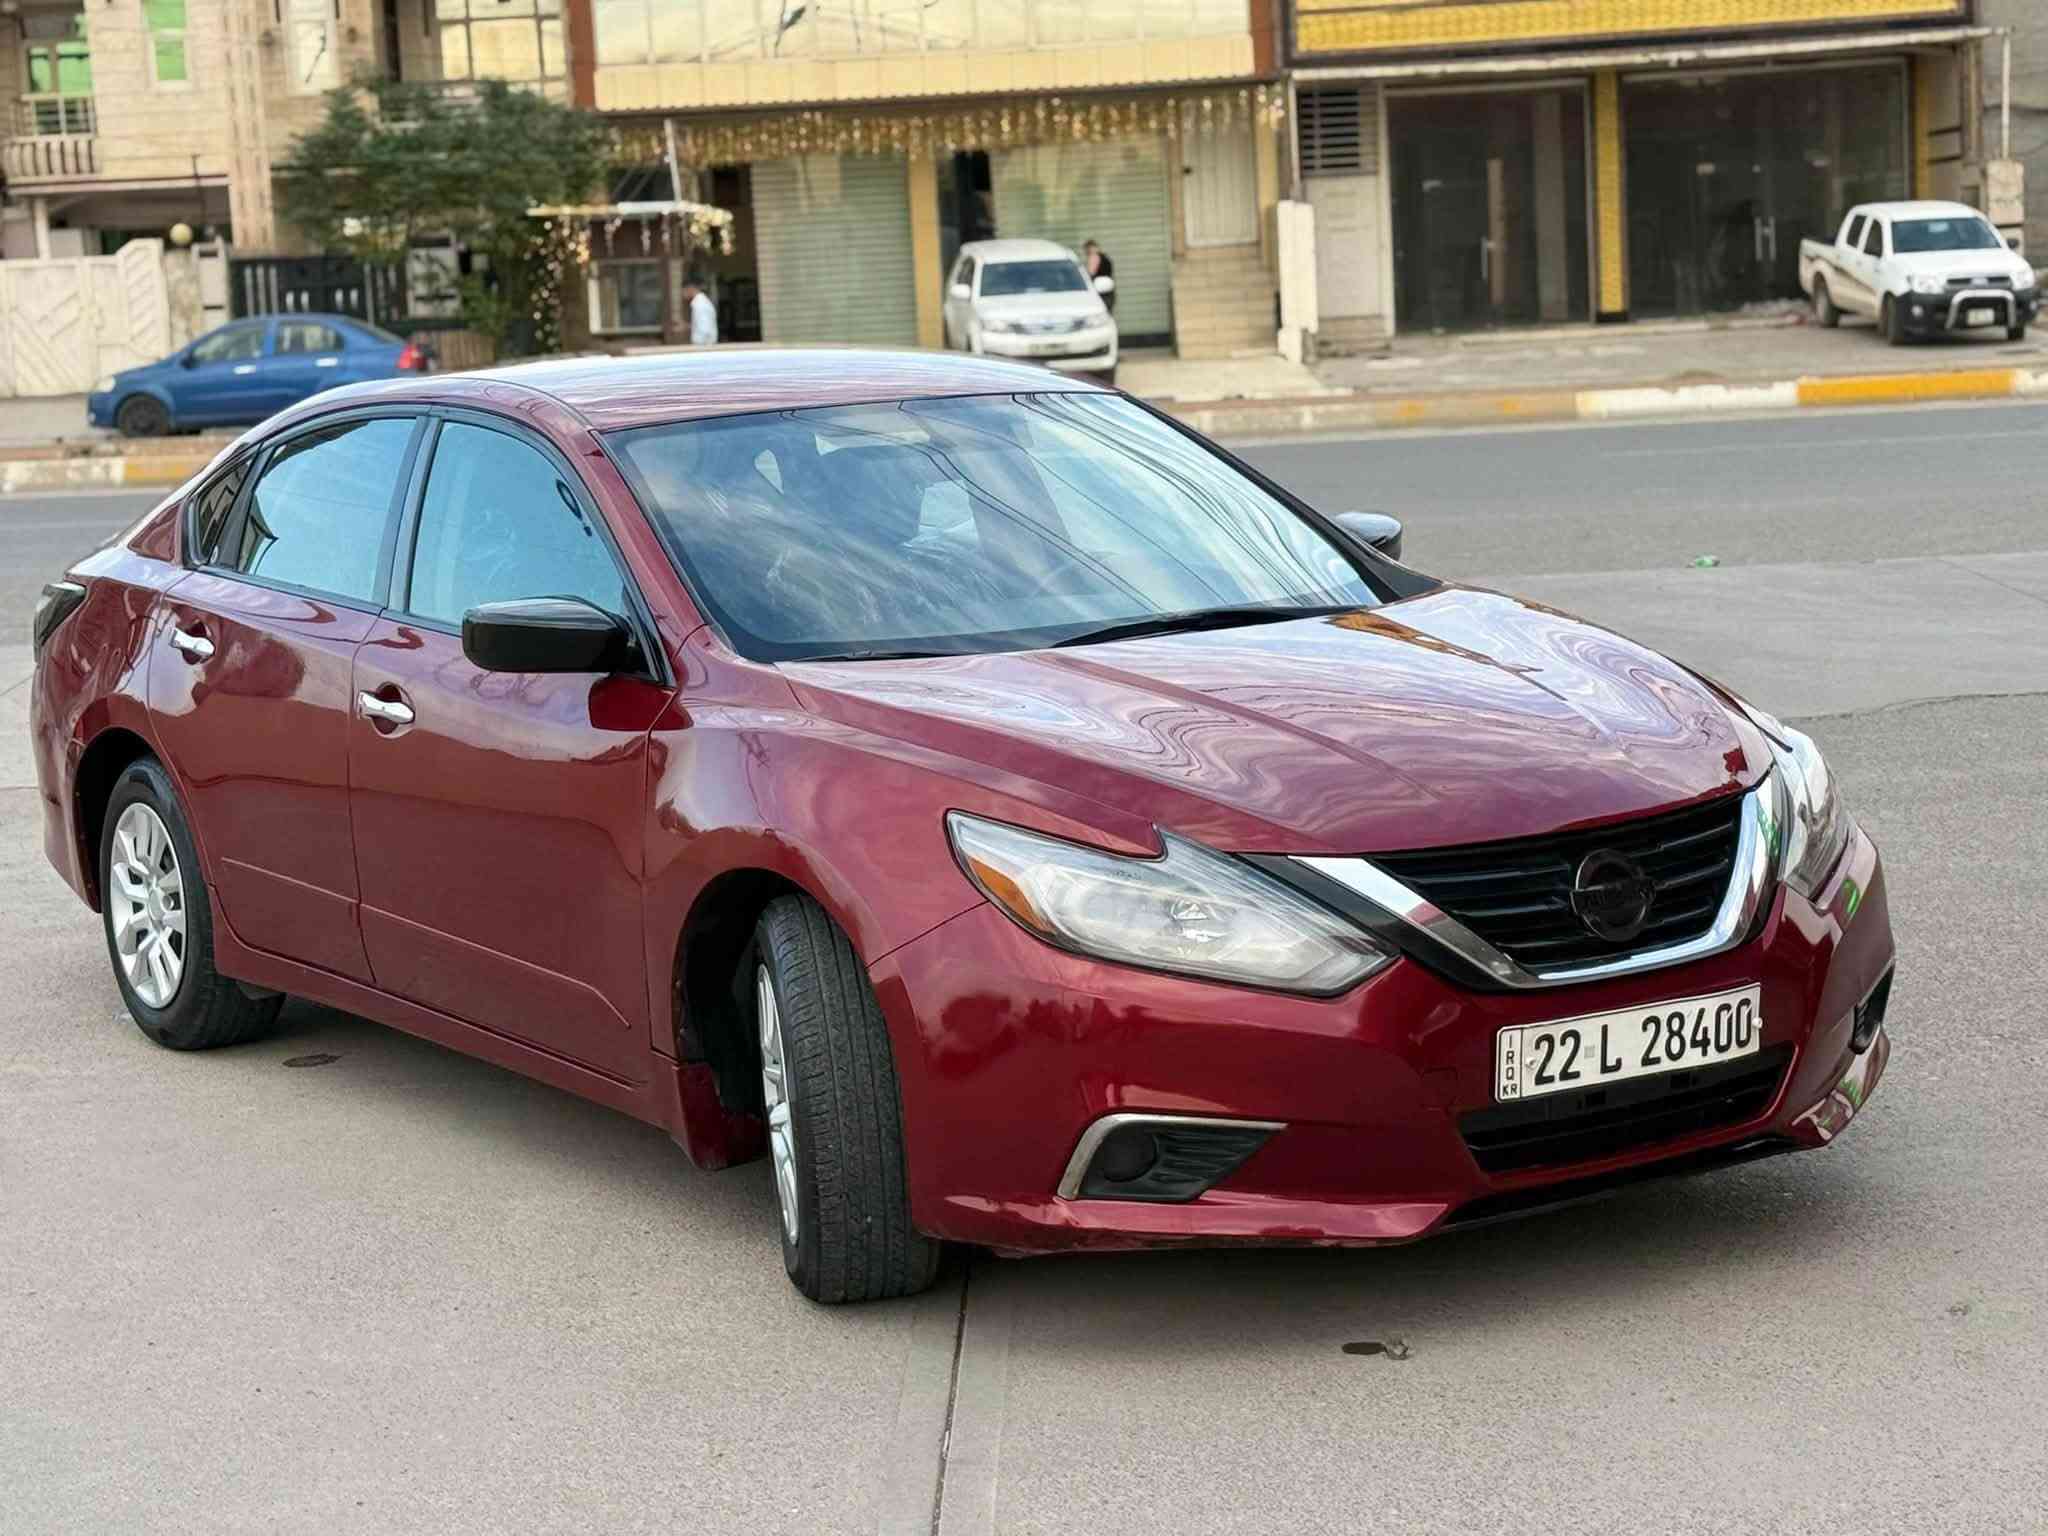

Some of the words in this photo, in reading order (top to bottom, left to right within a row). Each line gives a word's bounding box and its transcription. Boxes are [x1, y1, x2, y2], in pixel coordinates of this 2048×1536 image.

[1534, 1029, 1581, 1086] 22
[1600, 1024, 1622, 1074] L
[1641, 998, 1753, 1067] 28400
[1503, 1083, 1518, 1096] KR
